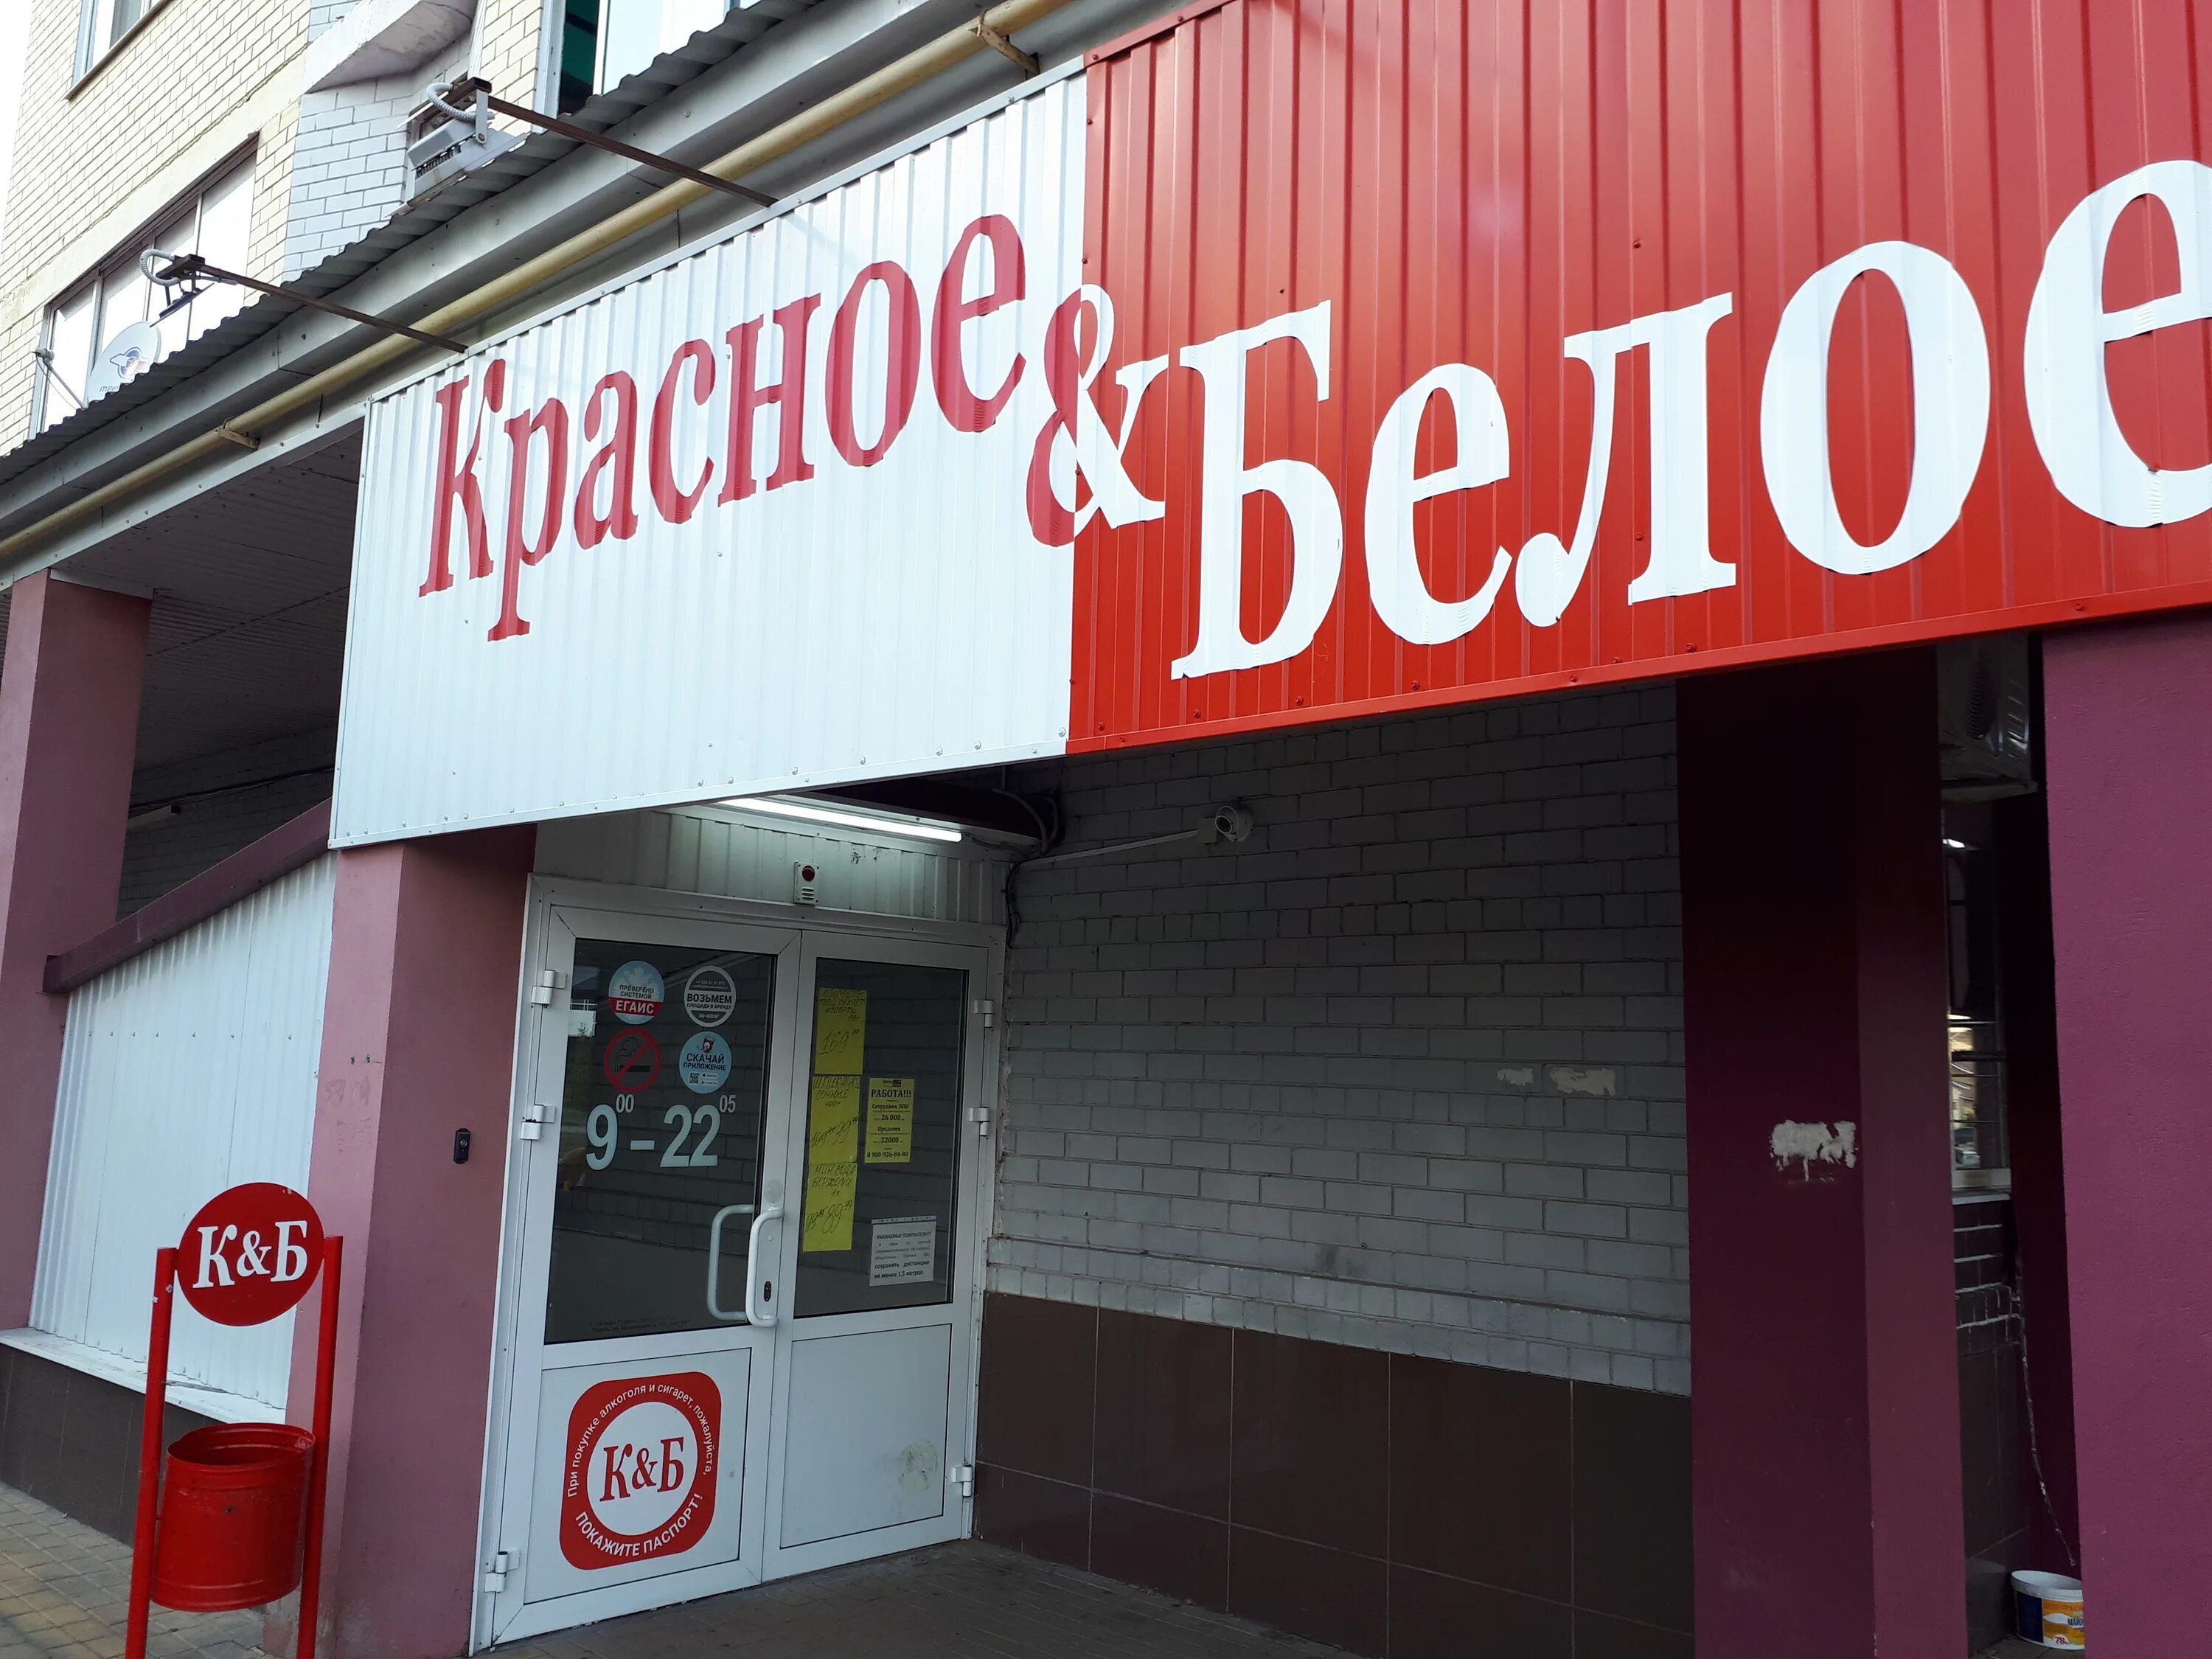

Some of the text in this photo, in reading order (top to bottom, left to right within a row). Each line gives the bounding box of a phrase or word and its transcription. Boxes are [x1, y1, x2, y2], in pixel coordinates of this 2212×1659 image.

[419, 160, 2212, 679] Красное & Белое
[619, 984, 655, 993] ПРОВЕРЕНО
[620, 991, 653, 1000] СИСТЕМОЙ
[687, 993, 732, 1004] ВОЗЬМЕМ
[616, 1000, 655, 1014] ЕГАИС
[686, 1053, 724, 1064] СКАЧАЙ
[683, 1062, 726, 1071] ПРИЛОЖЕНИЕ
[871, 1089, 911, 1098] РАБОТА!!!
[586, 1105, 618, 1170] 9
[660, 1105, 721, 1167] 22
[719, 1094, 737, 1113] 05
[192, 1220, 308, 1288] К&Б
[568, 1384, 714, 1498] При покупке алкоголя и сигарет, пожалуйста,
[599, 1437, 684, 1502] К&Б
[575, 1493, 703, 1557] ПОКАЖИТЕ ПАСПОРТ!
